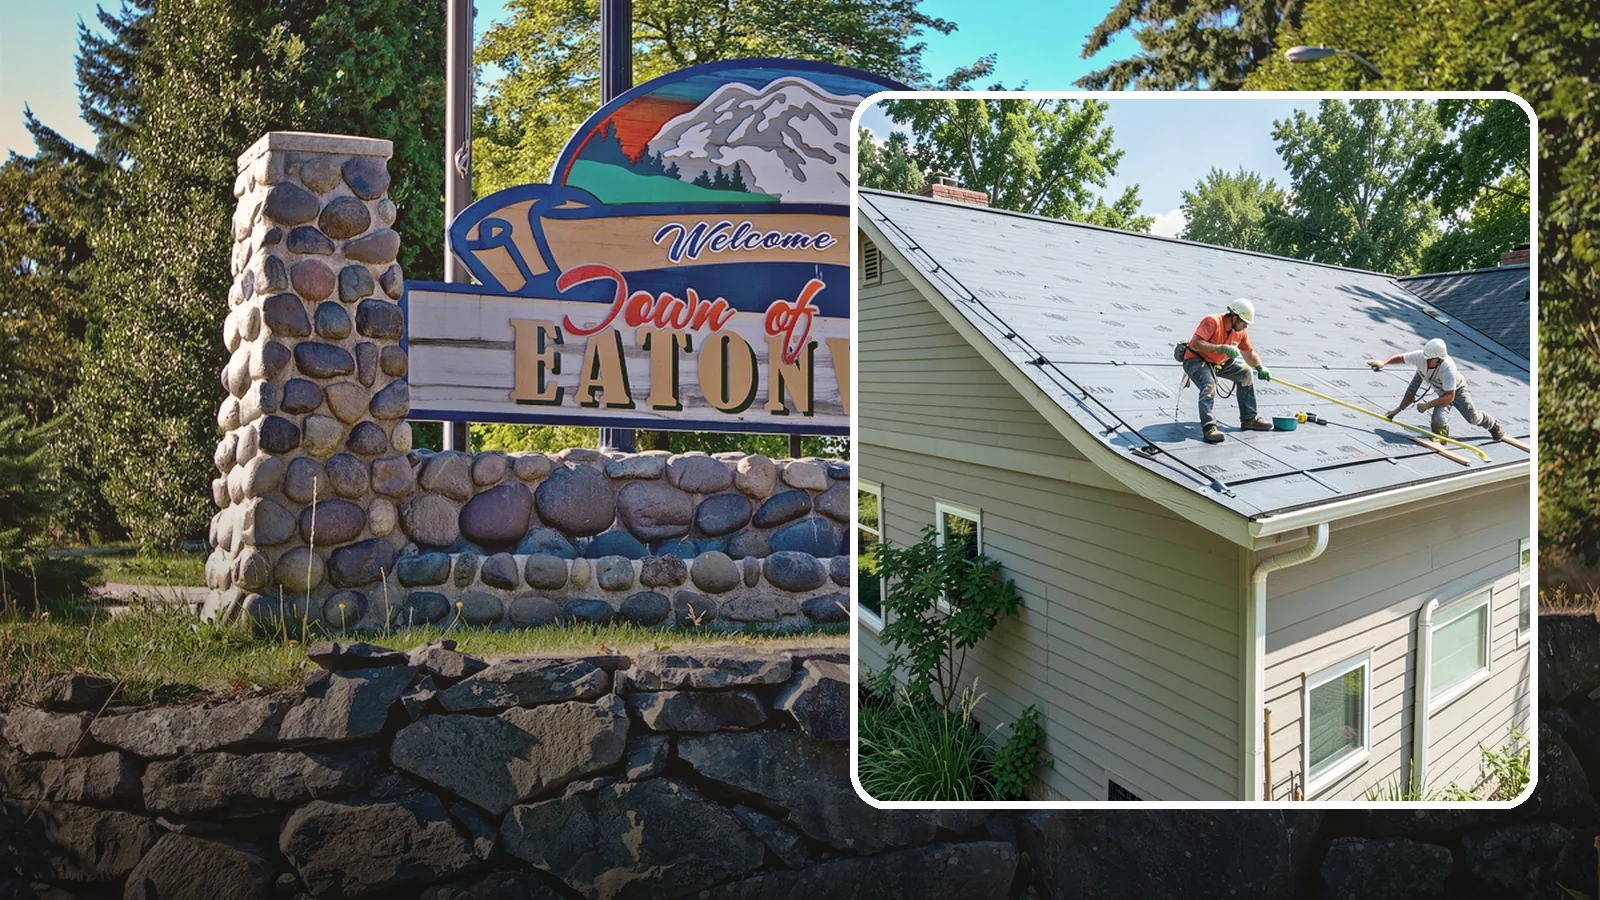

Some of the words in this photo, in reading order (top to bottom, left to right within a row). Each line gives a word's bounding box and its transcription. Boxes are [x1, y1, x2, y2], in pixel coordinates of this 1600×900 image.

[653, 220, 837, 264] Welcome
[556, 263, 738, 335] Town
[764, 278, 826, 365] of
